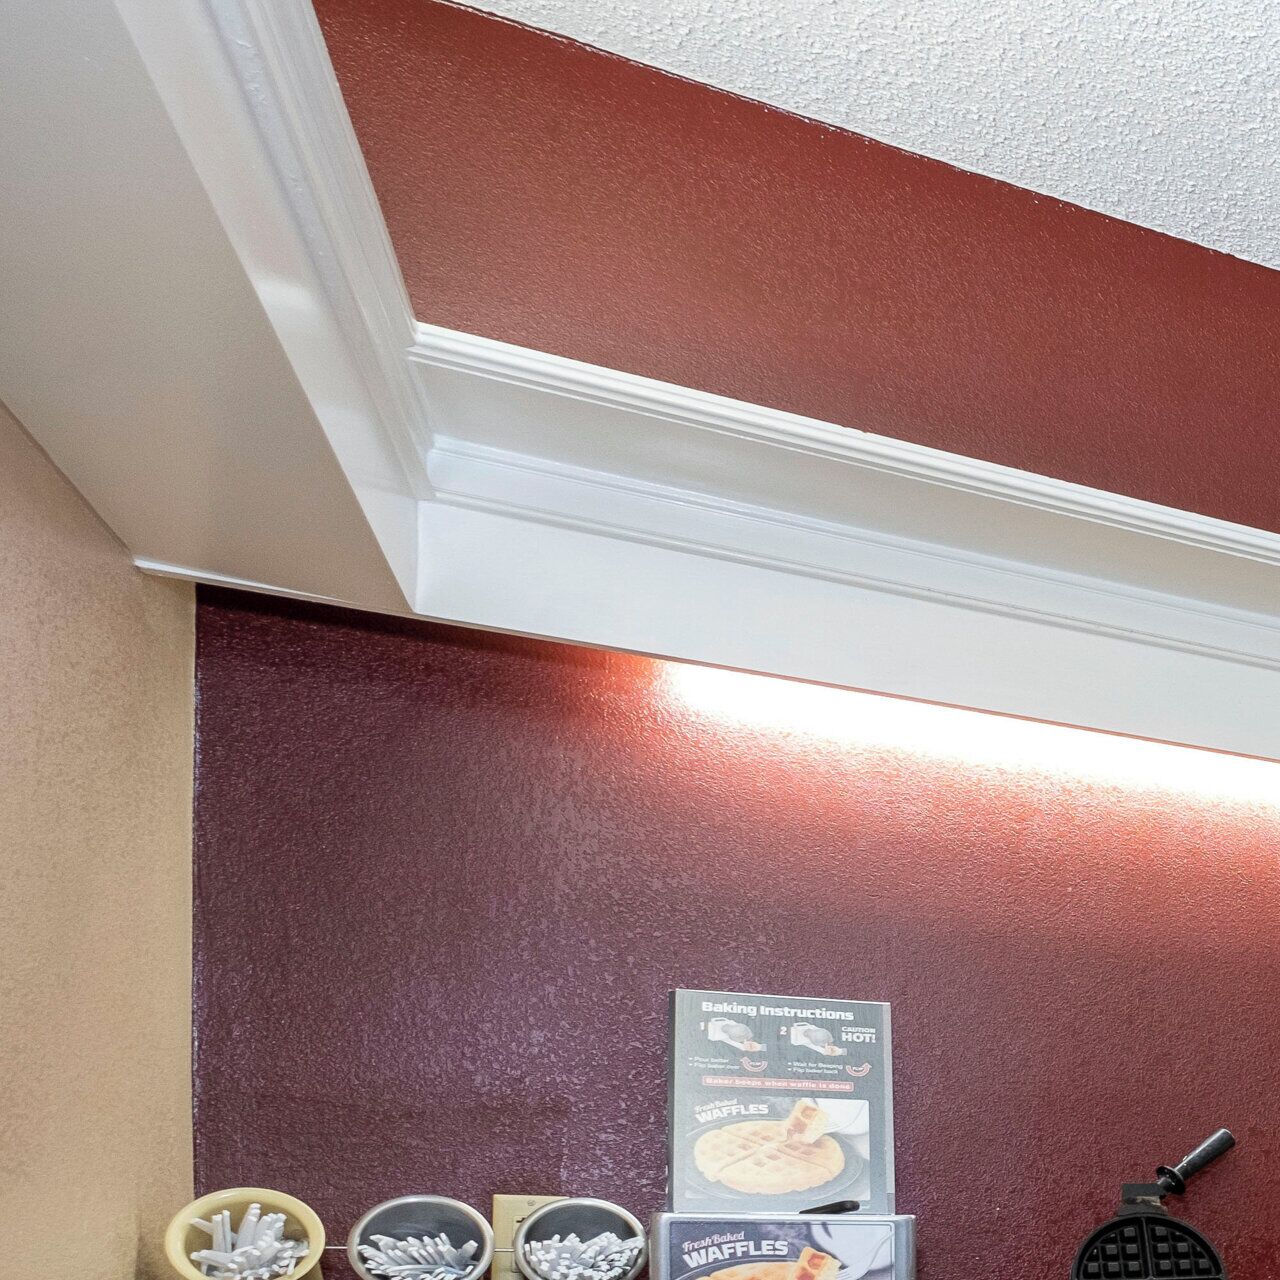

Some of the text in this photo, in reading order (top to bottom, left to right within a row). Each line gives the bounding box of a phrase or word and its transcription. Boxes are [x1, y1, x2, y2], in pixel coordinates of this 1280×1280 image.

[701, 1001, 854, 1020] Baking Instructions
[780, 1026, 787, 1035] 2
[841, 1033, 876, 1043] HOT!
[694, 1104, 769, 1123] WAFFLES
[682, 1231, 745, 1252] Fresh Baked
[682, 1240, 789, 1269] WAFFLES
